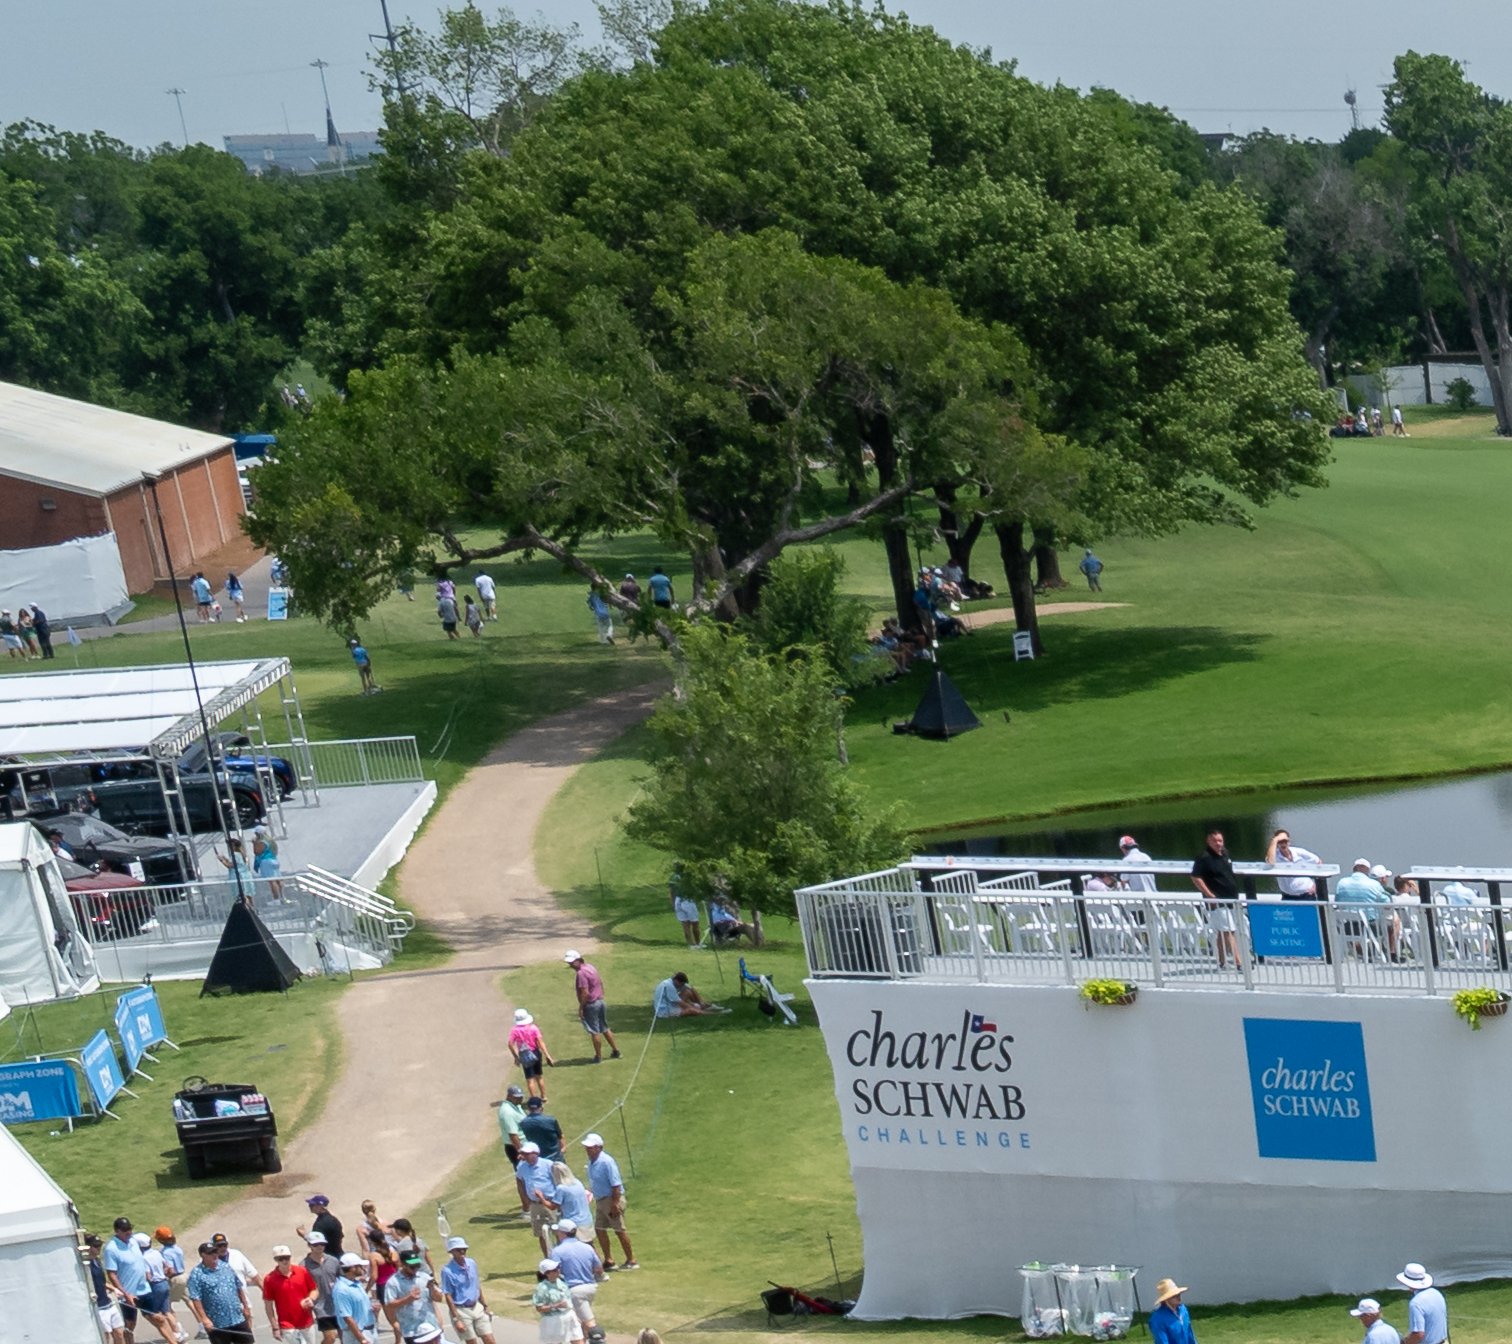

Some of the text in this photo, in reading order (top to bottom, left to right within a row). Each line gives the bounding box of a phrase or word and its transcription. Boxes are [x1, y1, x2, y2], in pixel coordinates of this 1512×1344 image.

[846, 1009, 1015, 1073] charles
[36, 1067, 64, 1077] ZONE
[1261, 1056, 1356, 1092] charles
[852, 1078, 1026, 1121] SCHWAB
[1263, 1094, 1361, 1119] SCHWAB
[858, 1125, 1031, 1149] CHALLENGE
